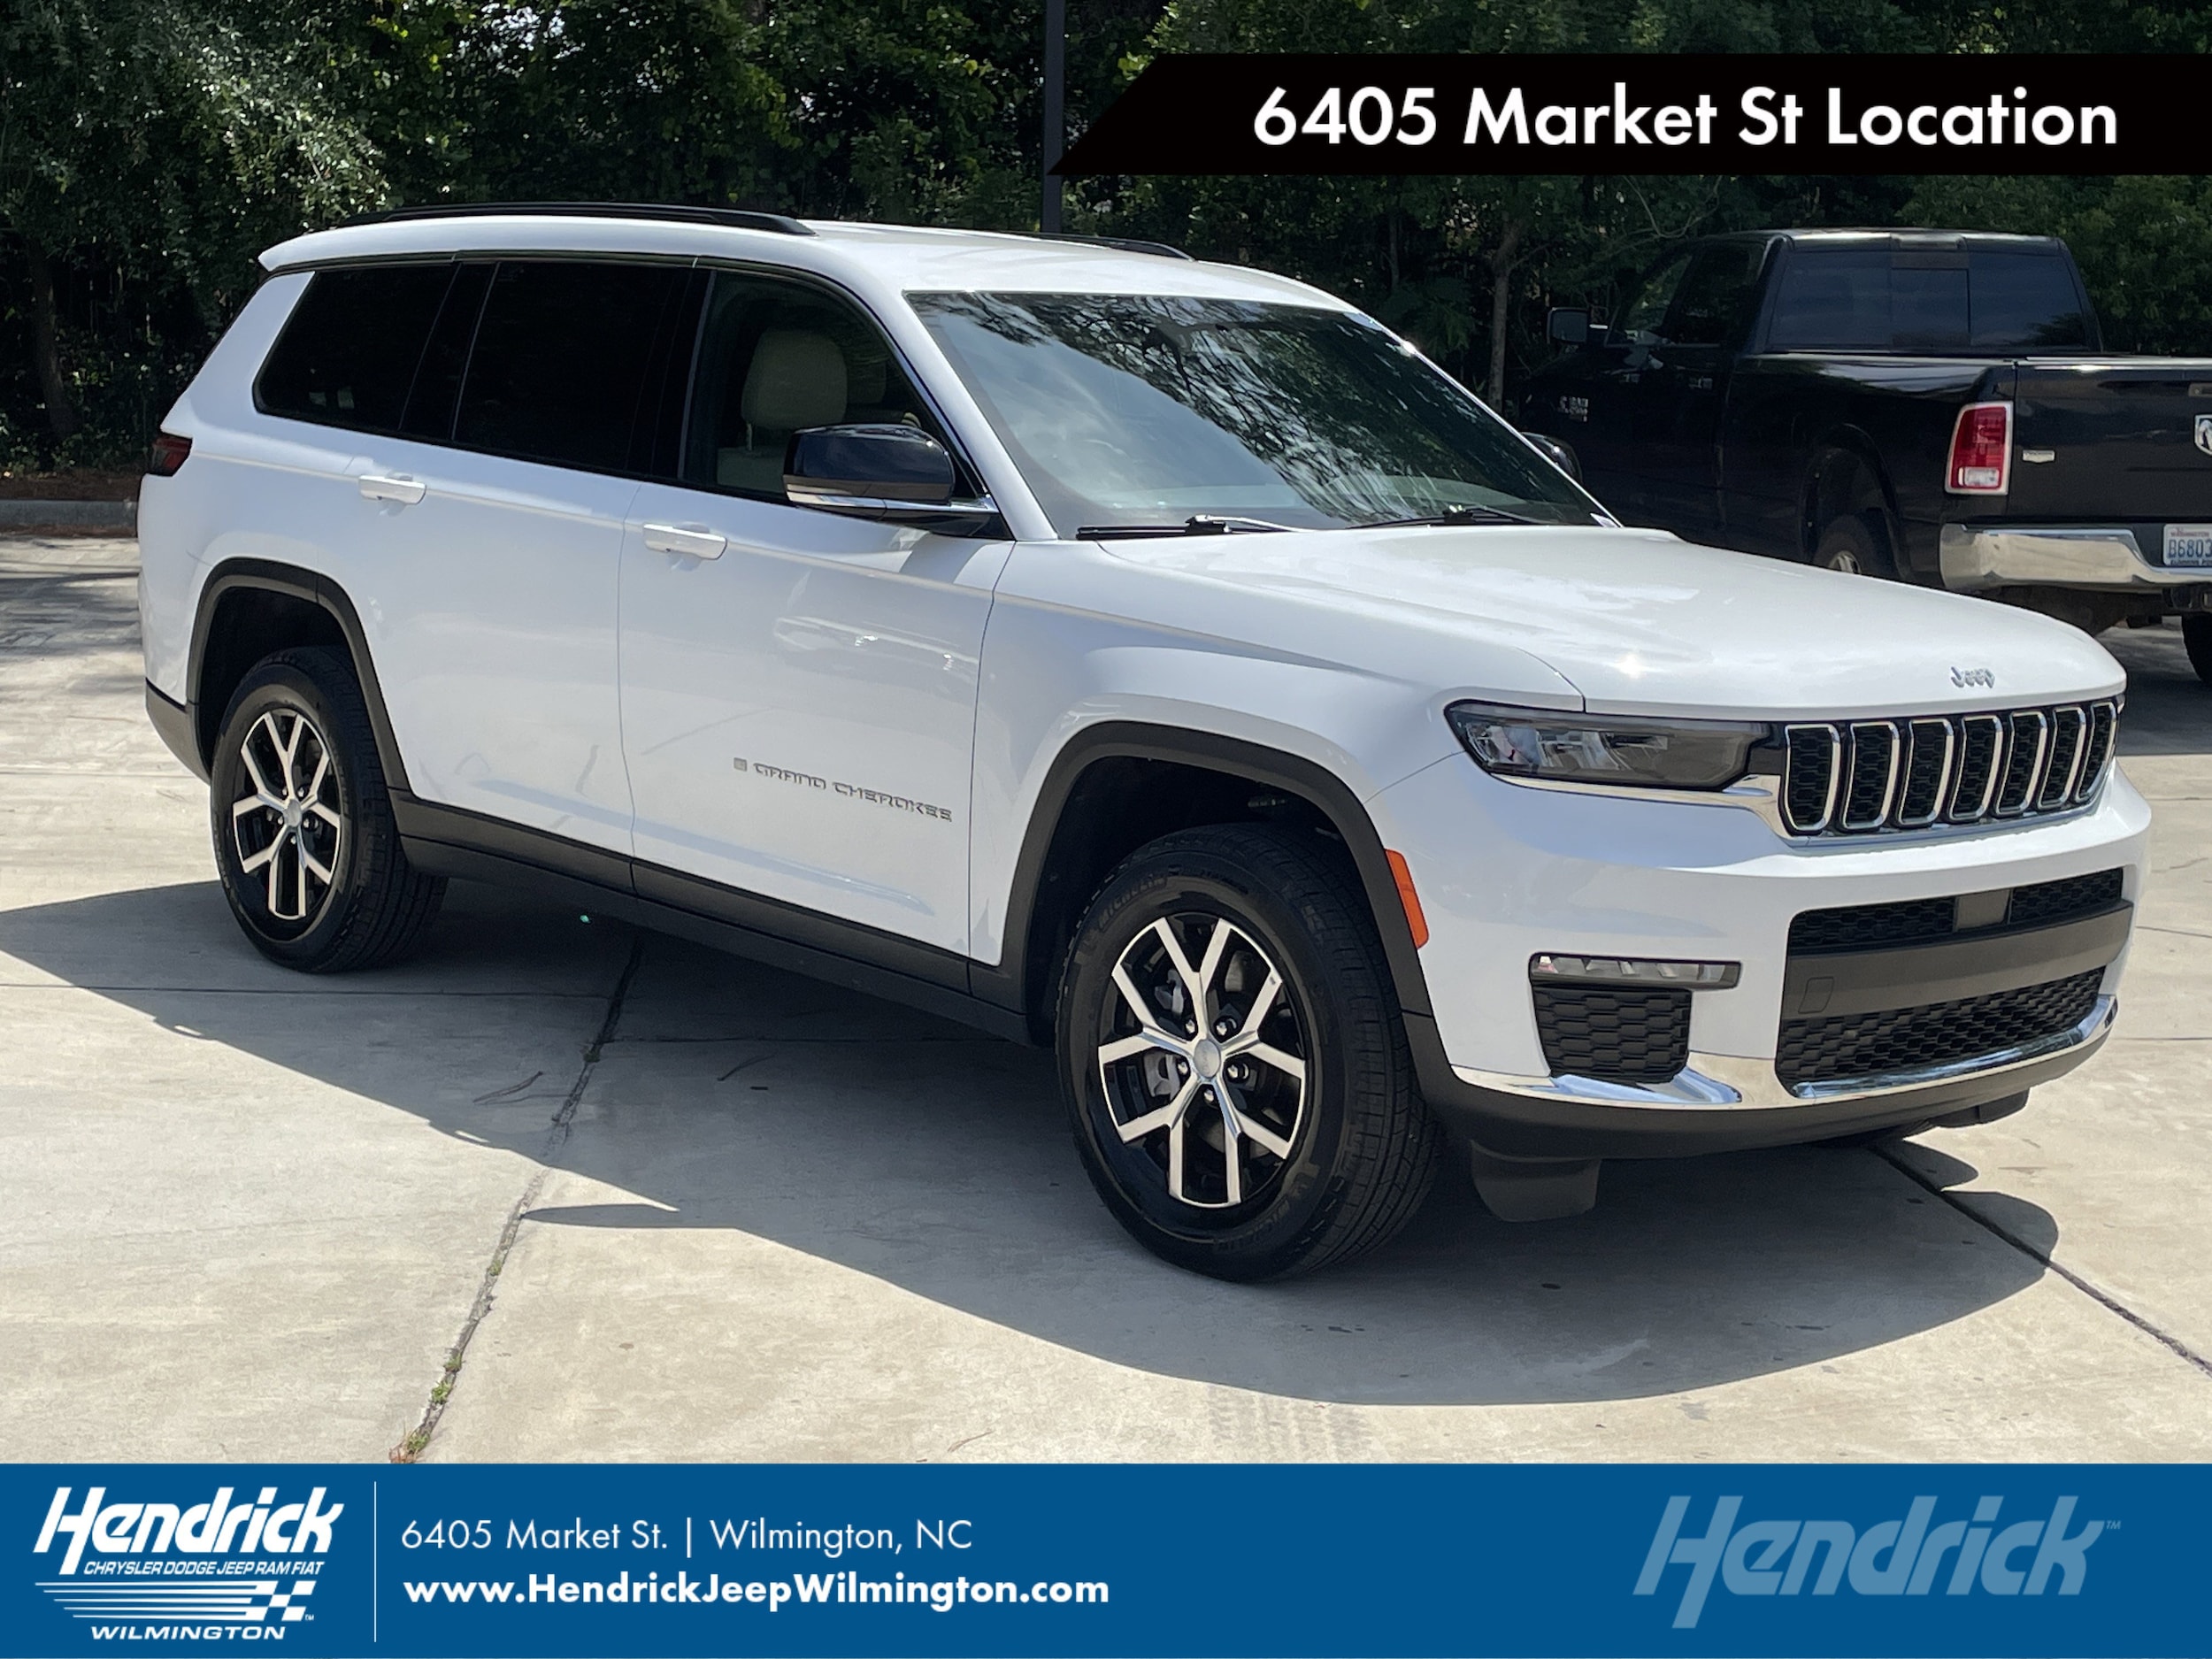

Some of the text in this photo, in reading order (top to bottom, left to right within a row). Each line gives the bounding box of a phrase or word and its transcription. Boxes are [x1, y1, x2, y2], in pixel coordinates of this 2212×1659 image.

[1951, 666, 1995, 688] Jeep
[753, 763, 953, 822] GRAND CHEROKEE
